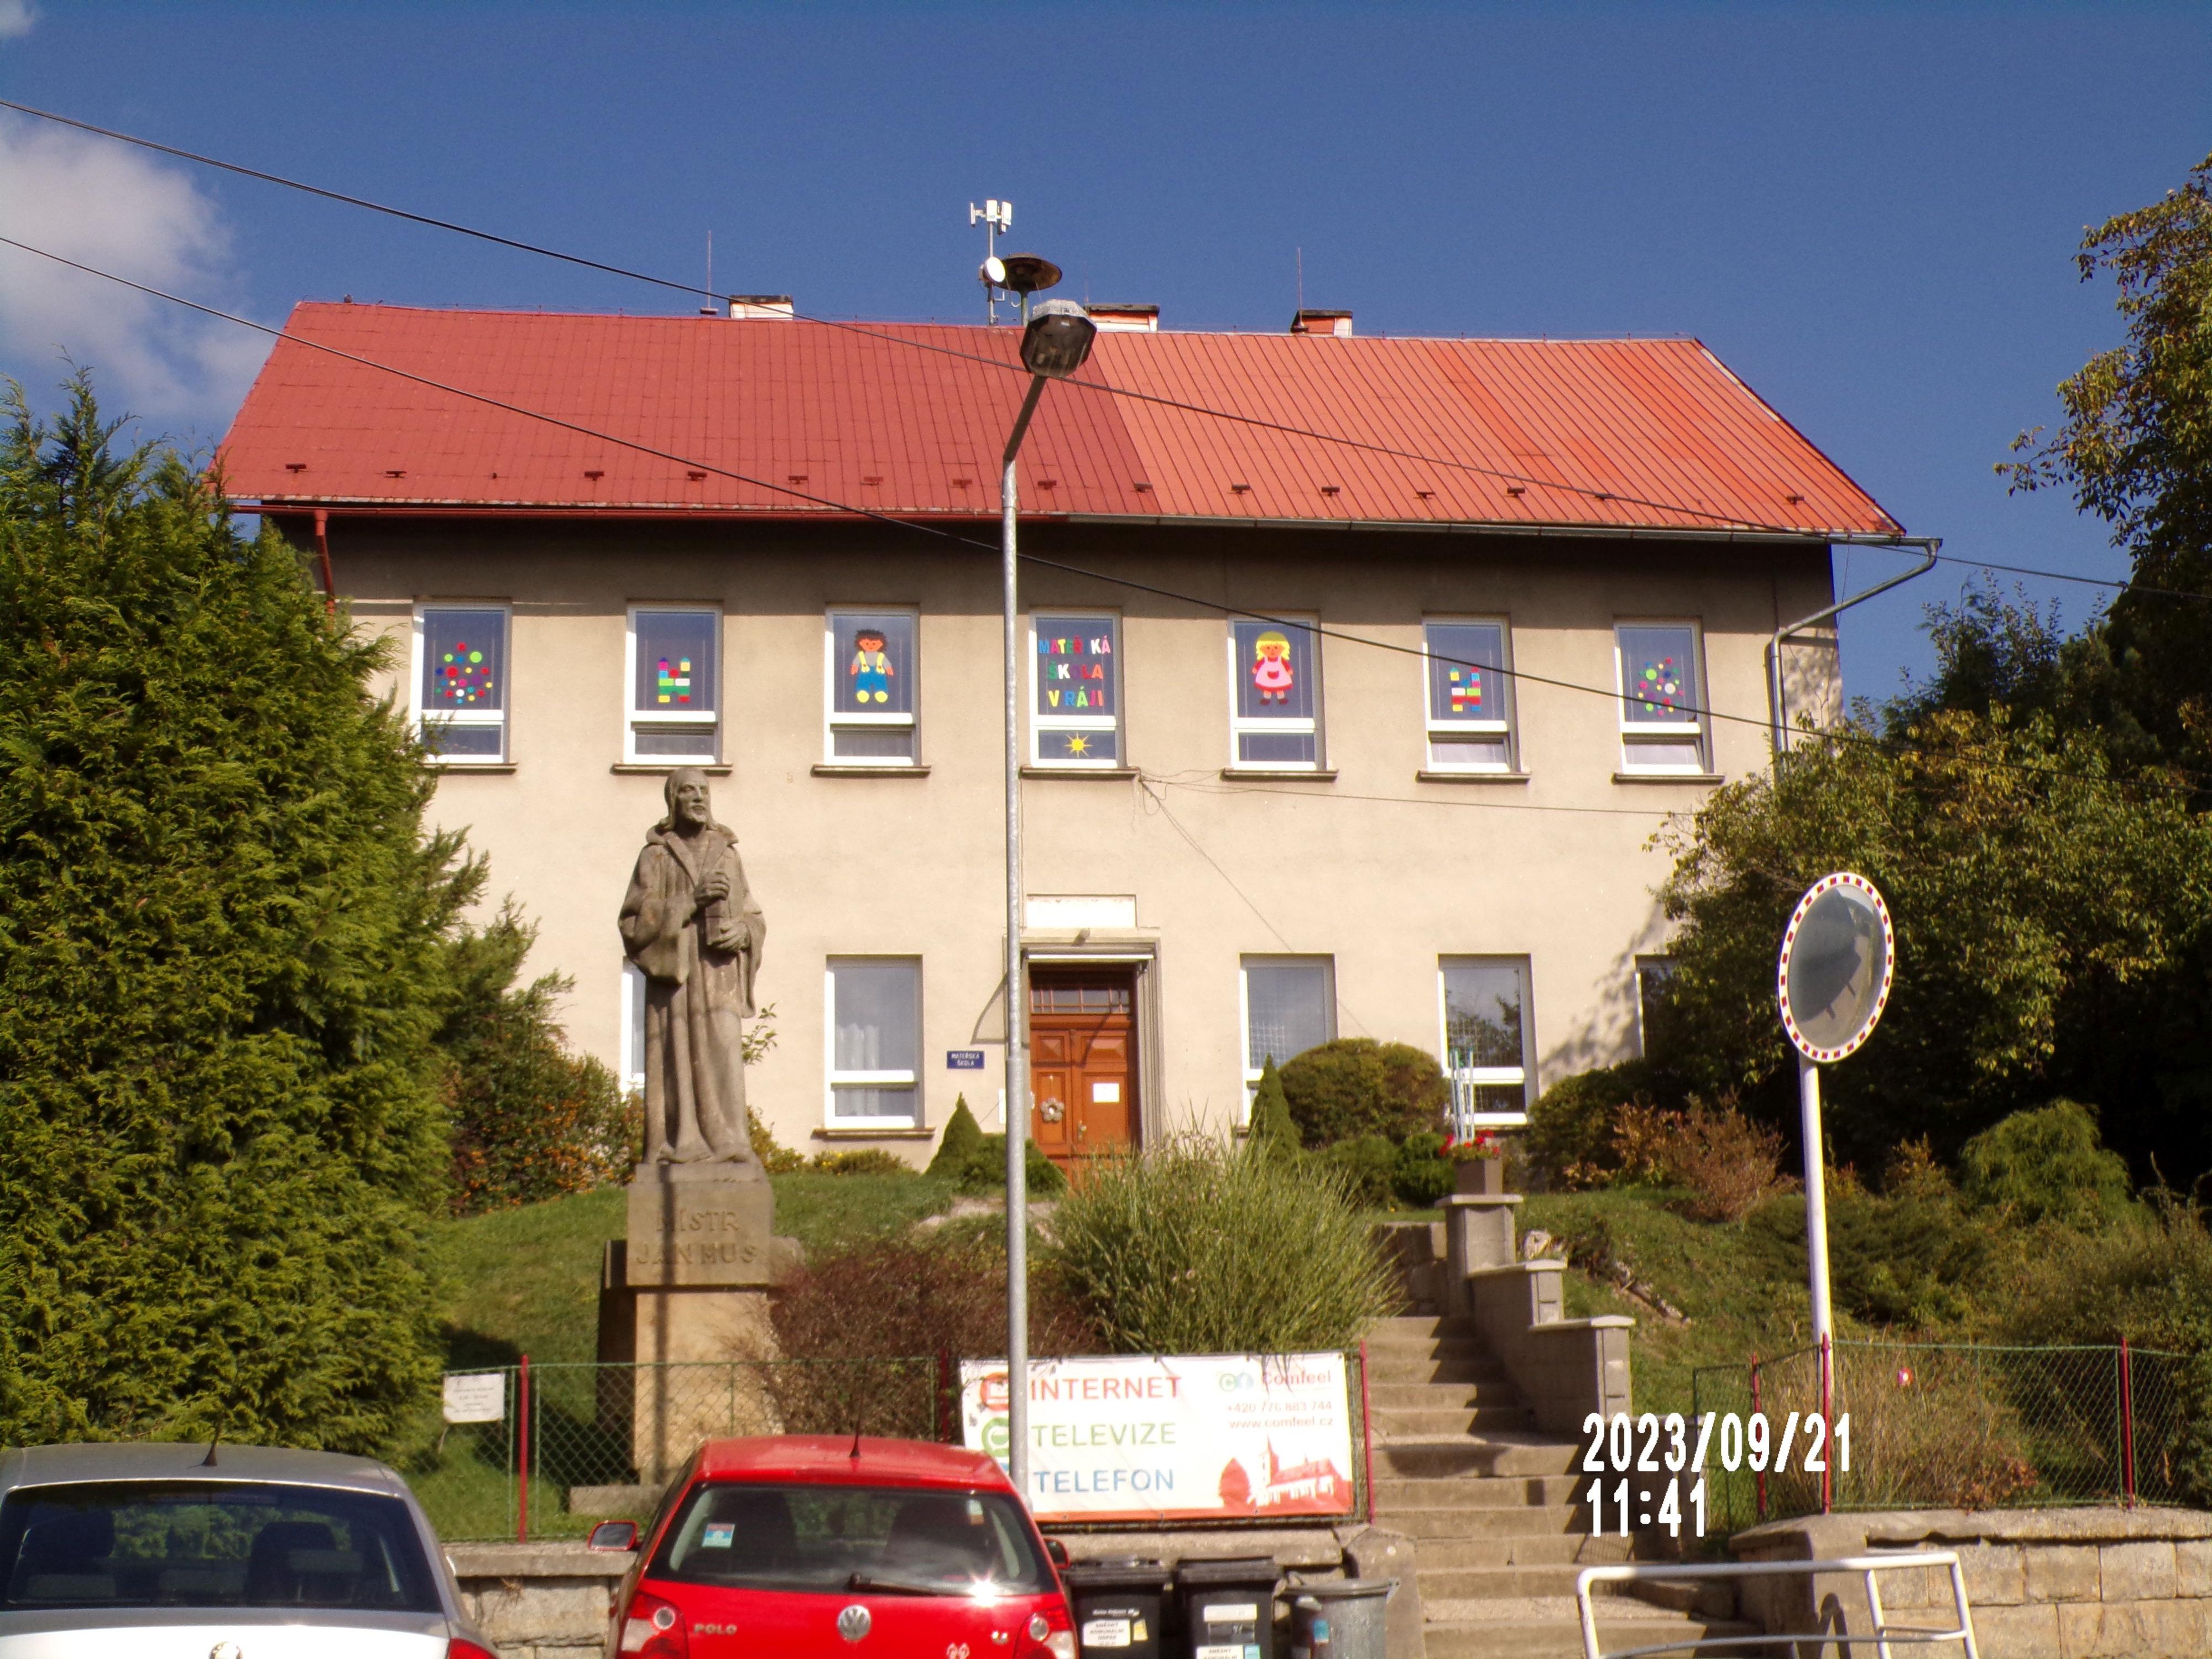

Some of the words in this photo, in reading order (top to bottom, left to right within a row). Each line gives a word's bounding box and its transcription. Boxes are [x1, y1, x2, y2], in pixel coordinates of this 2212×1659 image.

[1038, 635, 1110, 654] MATEŘKÁ
[1047, 661, 1103, 679] ŠKOLA
[1048, 690, 1060, 707] V
[1063, 686, 1103, 707] RÁJI
[637, 1243, 692, 1264] JN
[1030, 1376, 1181, 1400] INTERNET
[1031, 1422, 1177, 1447] TELEVIZE
[1034, 1469, 1173, 1493] TELEFON
[694, 1623, 738, 1636] POLO
